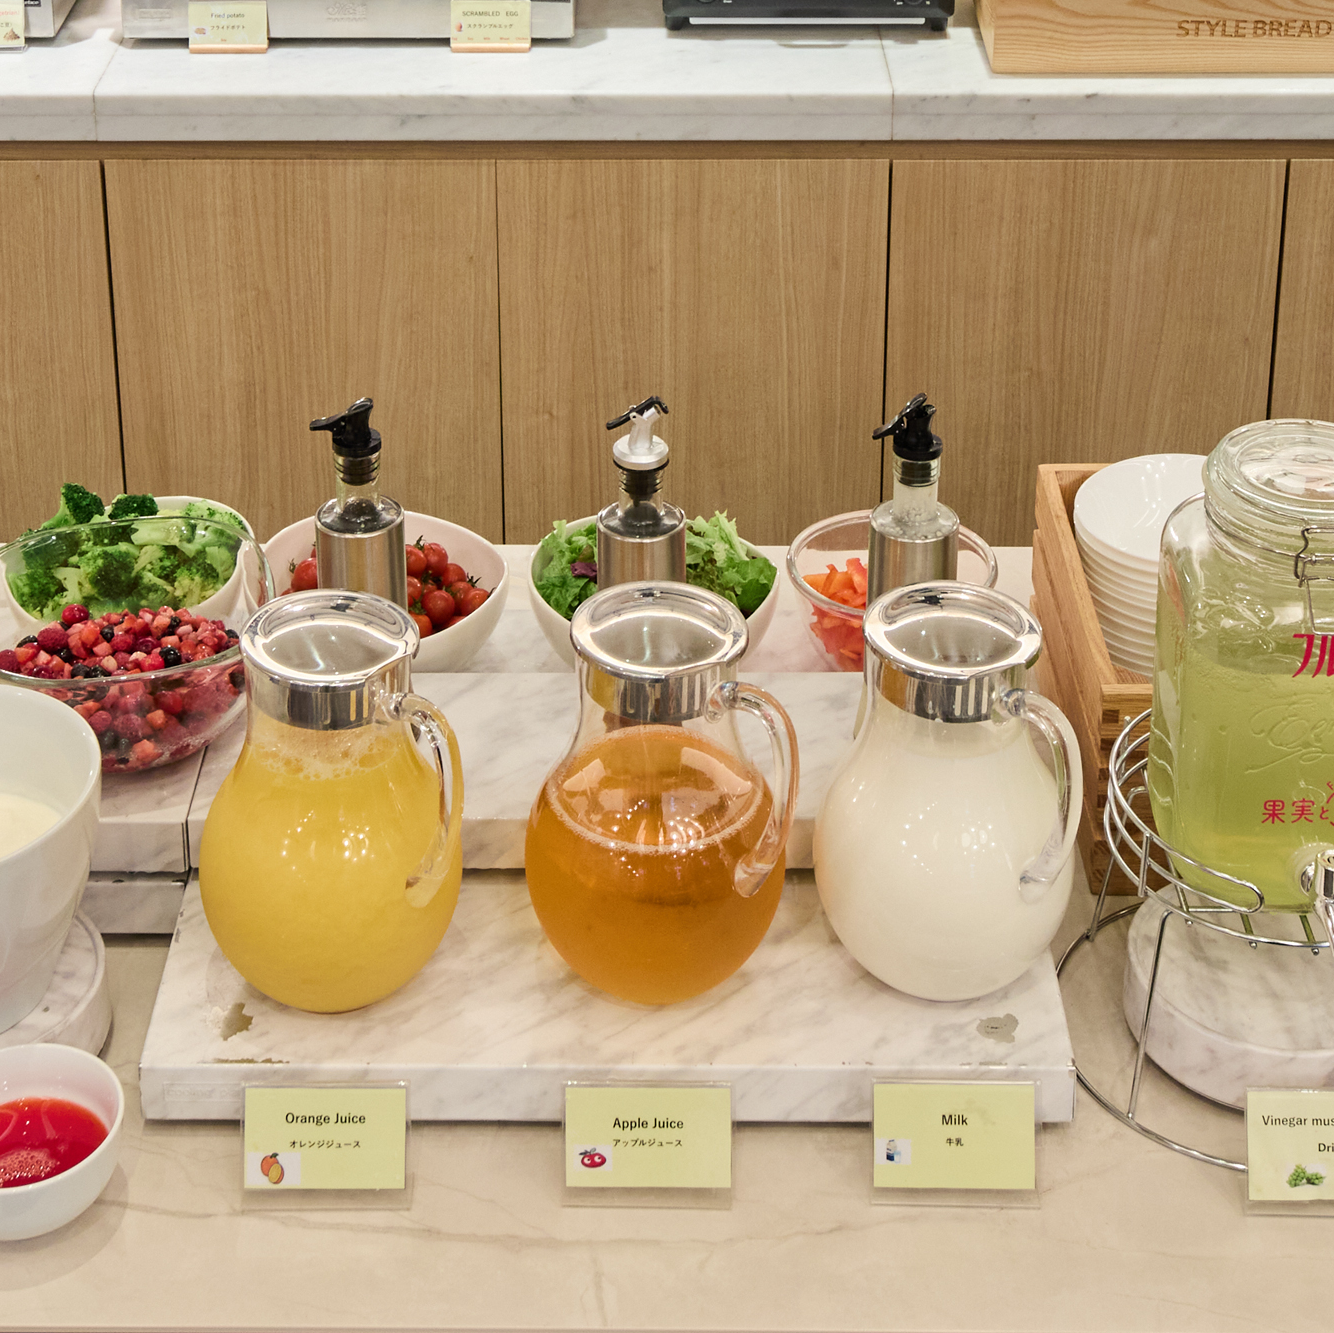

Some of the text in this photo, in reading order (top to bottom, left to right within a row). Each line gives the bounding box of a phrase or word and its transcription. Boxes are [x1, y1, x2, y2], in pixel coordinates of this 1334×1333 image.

[1176, 19, 1333, 37] STYLE BREAD
[285, 1112, 366, 1126] Orange Juice
[612, 1117, 684, 1131] Apple Juice
[941, 1114, 969, 1126] Milk
[1262, 1115, 1308, 1128] Vinegar
[289, 1139, 361, 1149] オレンジジュース
[613, 1138, 683, 1147] アップルジュース
[945, 1137, 965, 1147] 牛乳
